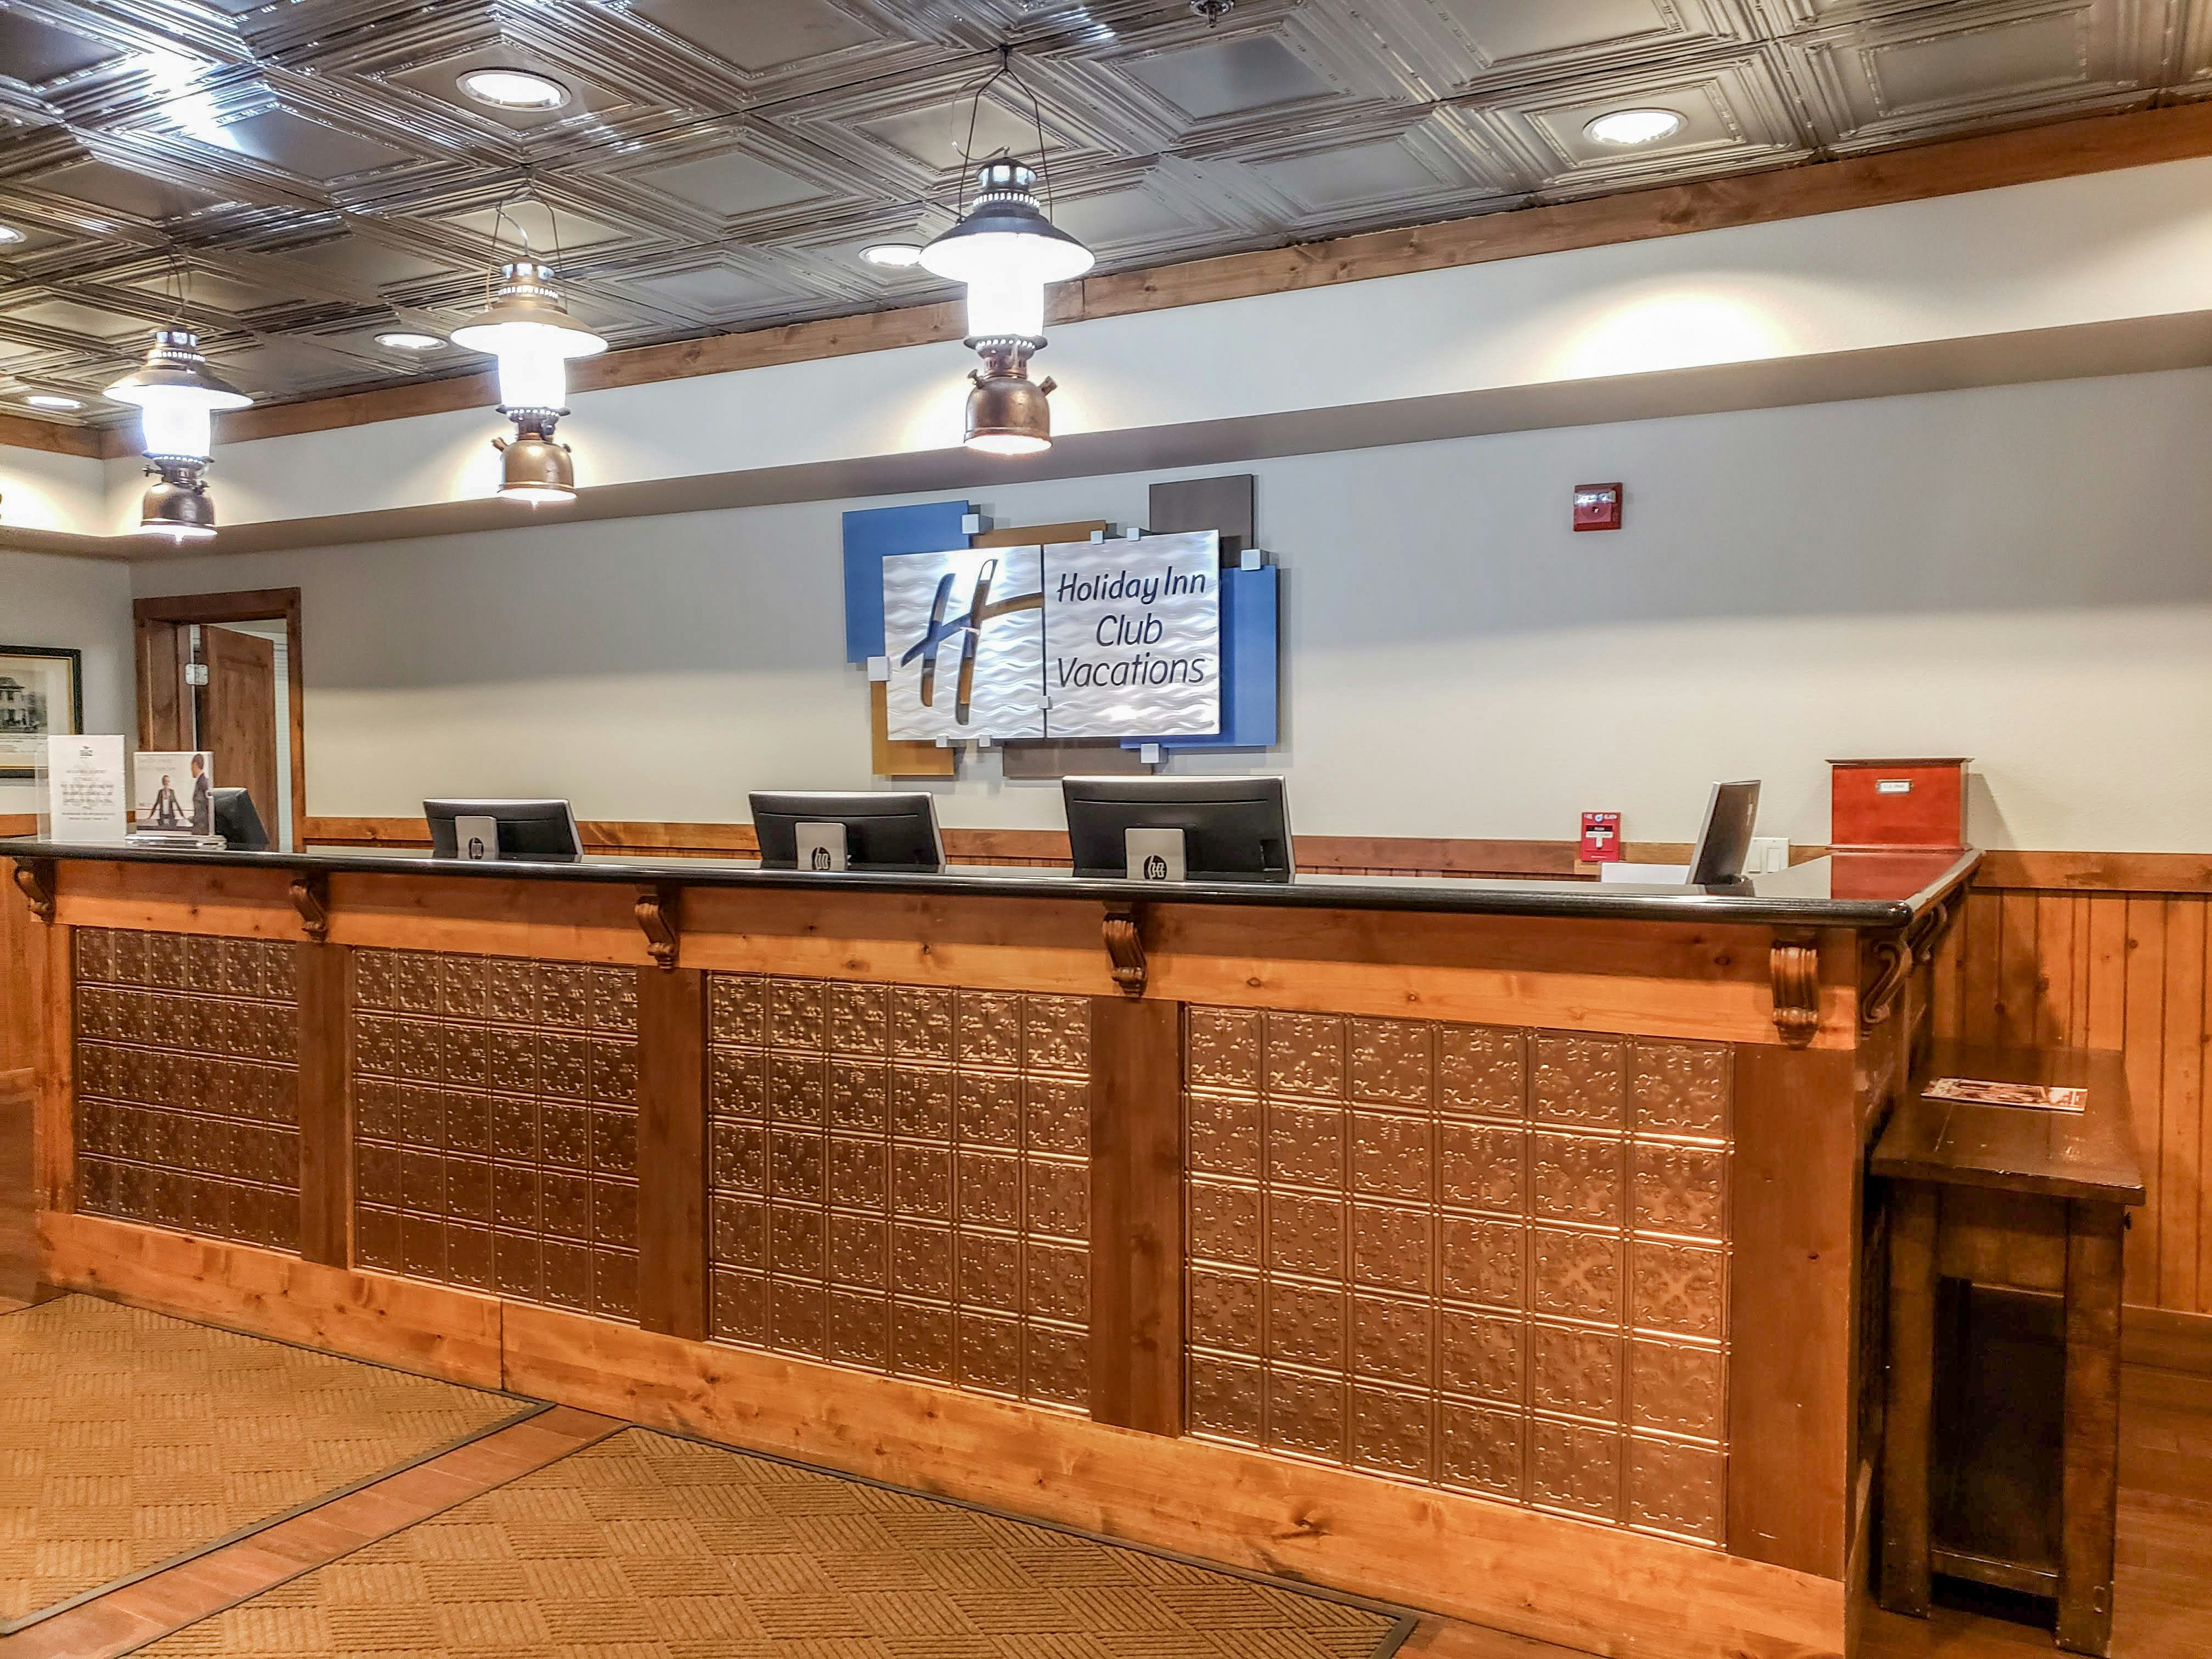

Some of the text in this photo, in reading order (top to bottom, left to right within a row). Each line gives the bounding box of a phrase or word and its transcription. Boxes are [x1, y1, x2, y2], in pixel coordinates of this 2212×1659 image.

[1057, 566, 1205, 605] Holiday Inn
[1097, 613, 1162, 646] Club
[1058, 652, 1205, 687] Vacations
